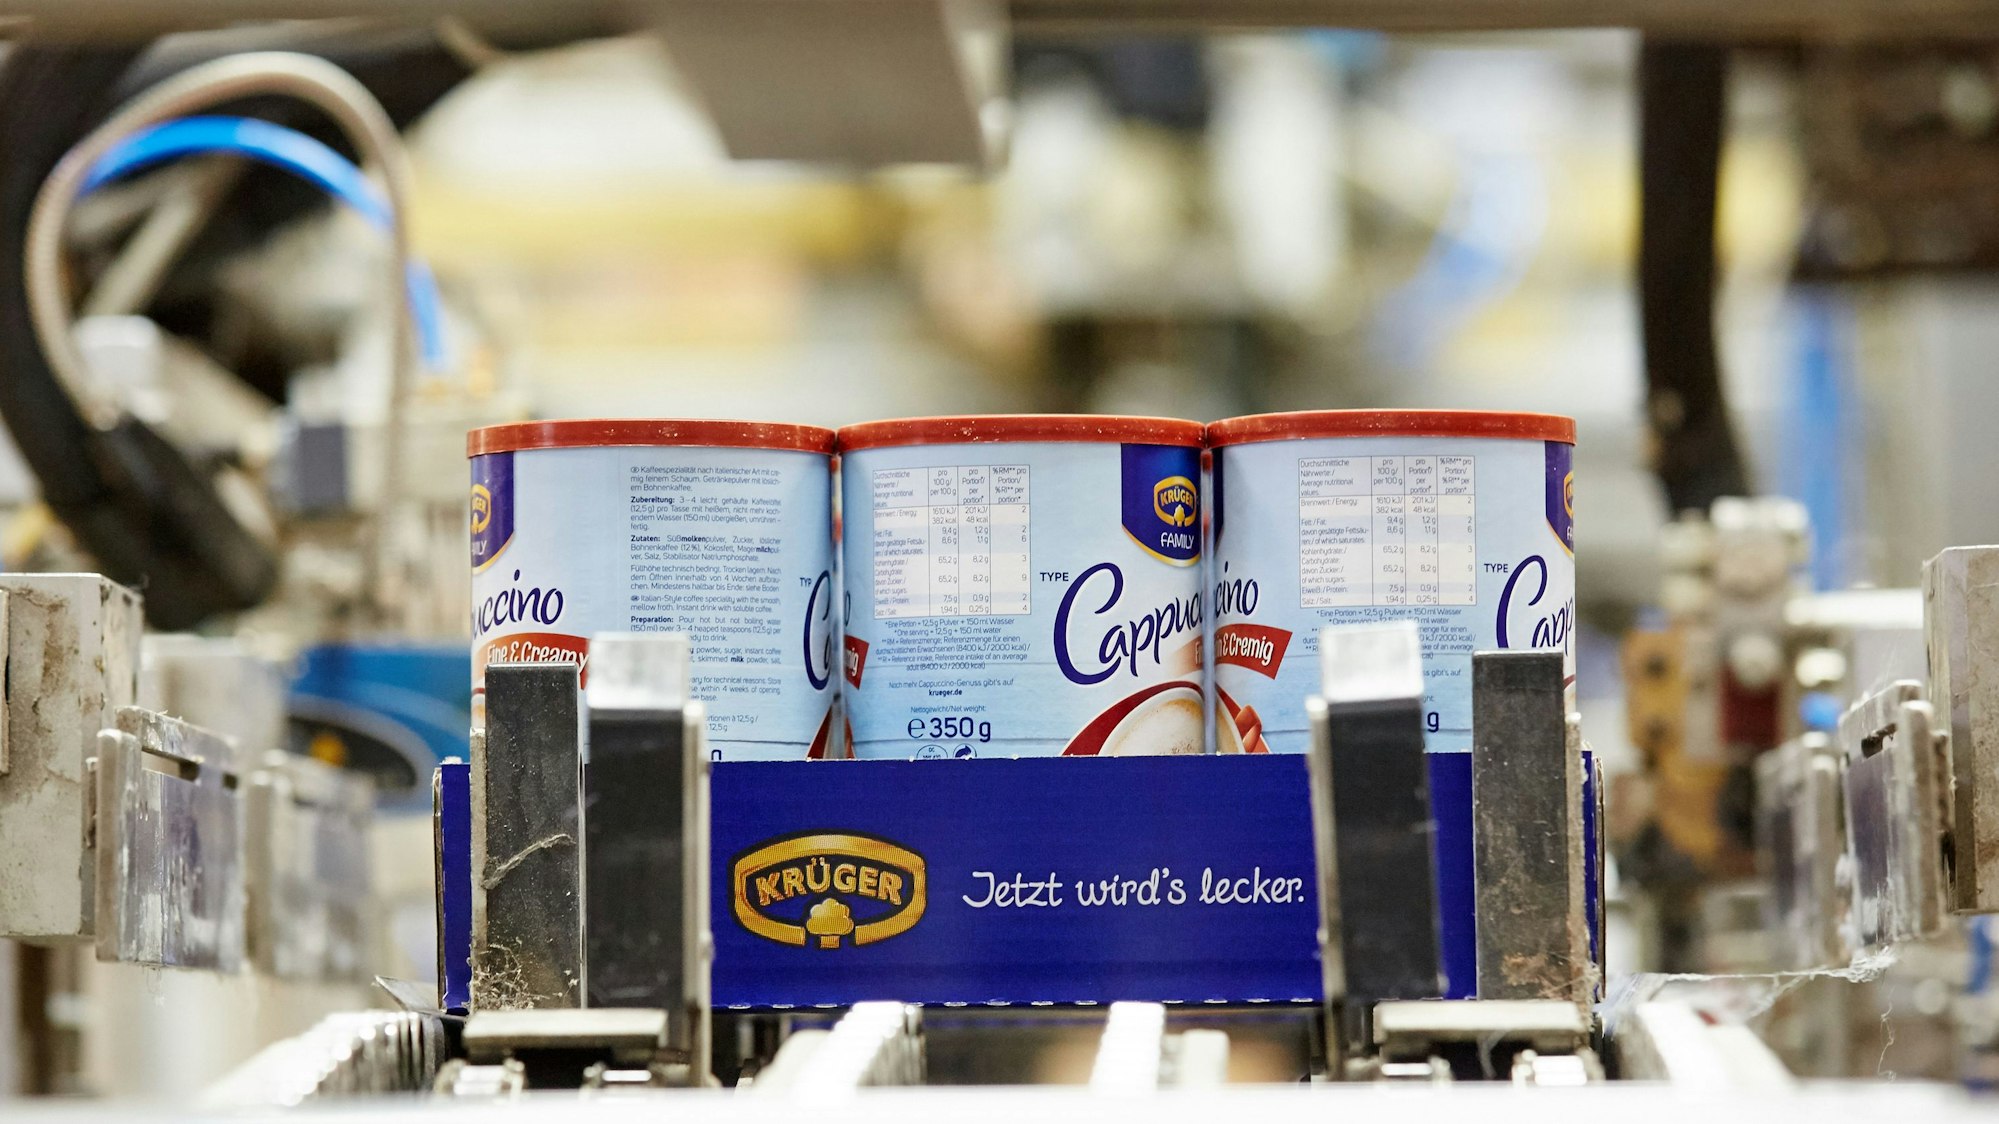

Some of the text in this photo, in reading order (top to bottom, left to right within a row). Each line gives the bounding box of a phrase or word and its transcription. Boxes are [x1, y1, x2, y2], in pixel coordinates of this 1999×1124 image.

[1301, 459, 1349, 468] Durchschnittliche
[715, 467, 750, 475] italienischer
[631, 475, 643, 483] mig
[703, 475, 750, 484] Getränkepulver
[631, 496, 675, 504] Zubereitung:
[721, 497, 748, 505] gehäufte
[631, 523, 649, 531] fertig.
[1161, 532, 1195, 549] FAMILY
[631, 564, 661, 572] Füllhöhe
[1484, 564, 1508, 573] TYPE
[1040, 572, 1069, 582] TYPE
[641, 595, 682, 603] Italian-Style
[705, 596, 735, 604] speciality
[631, 616, 673, 624] Preparation:
[745, 617, 763, 625] boiling
[720, 626, 751, 634] teaspoons
[1223, 633, 1229, 656] &
[1229, 633, 1274, 666] Cremig
[1432, 669, 1449, 677] gibt's
[919, 679, 982, 688] Cappuccino-Genuss
[983, 679, 1001, 688] gibt's
[928, 689, 962, 697] krueger.de
[1427, 712, 1439, 733] g
[929, 717, 991, 743] 350 g
[755, 856, 904, 907] KRÜGER
[962, 868, 1306, 908] Jetzt wird's lecker.
